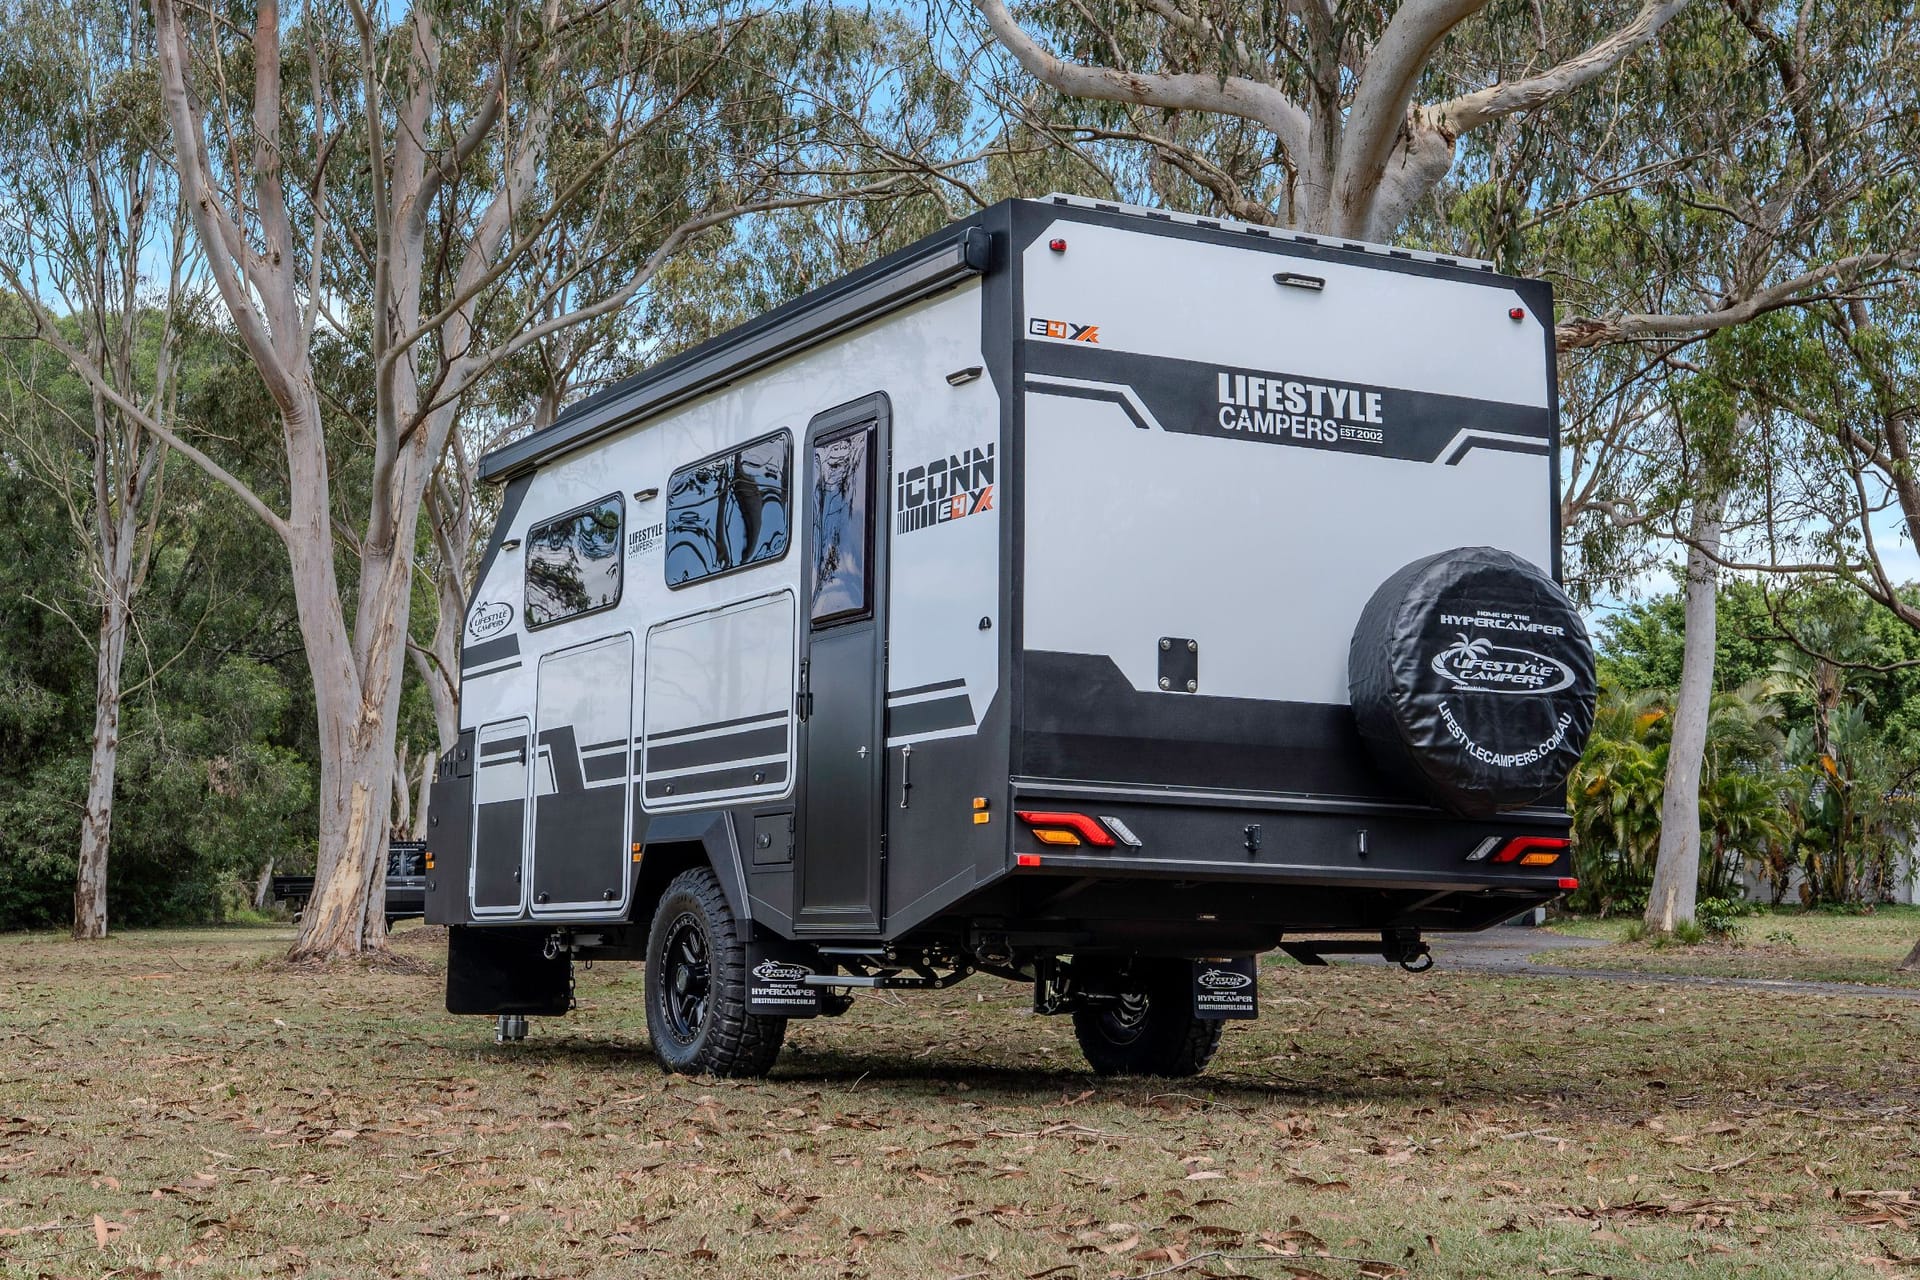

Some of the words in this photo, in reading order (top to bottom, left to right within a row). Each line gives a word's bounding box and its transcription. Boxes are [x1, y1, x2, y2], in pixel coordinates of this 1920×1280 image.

[1218, 372, 1383, 424] LIFESTYLE
[1218, 405, 1338, 443] CAMPERS
[1340, 427, 1354, 438] EST
[1356, 429, 1383, 441] 2002
[629, 522, 663, 546] LIFESTYLE
[628, 538, 654, 556] CAMPERS
[474, 609, 508, 627] LIFESTYLE
[1476, 610, 1500, 618] HOME
[1501, 612, 1512, 620] OF
[1513, 613, 1530, 622] THE
[477, 618, 505, 633] CAMPERS
[1440, 614, 1566, 637] HYPERCAMPER
[1452, 657, 1555, 677] LIFESTYLE
[1459, 670, 1545, 686] CAMPERS
[751, 987, 817, 998] HYPERCAMPER
[1197, 994, 1253, 1003] HYPERCAMPER
